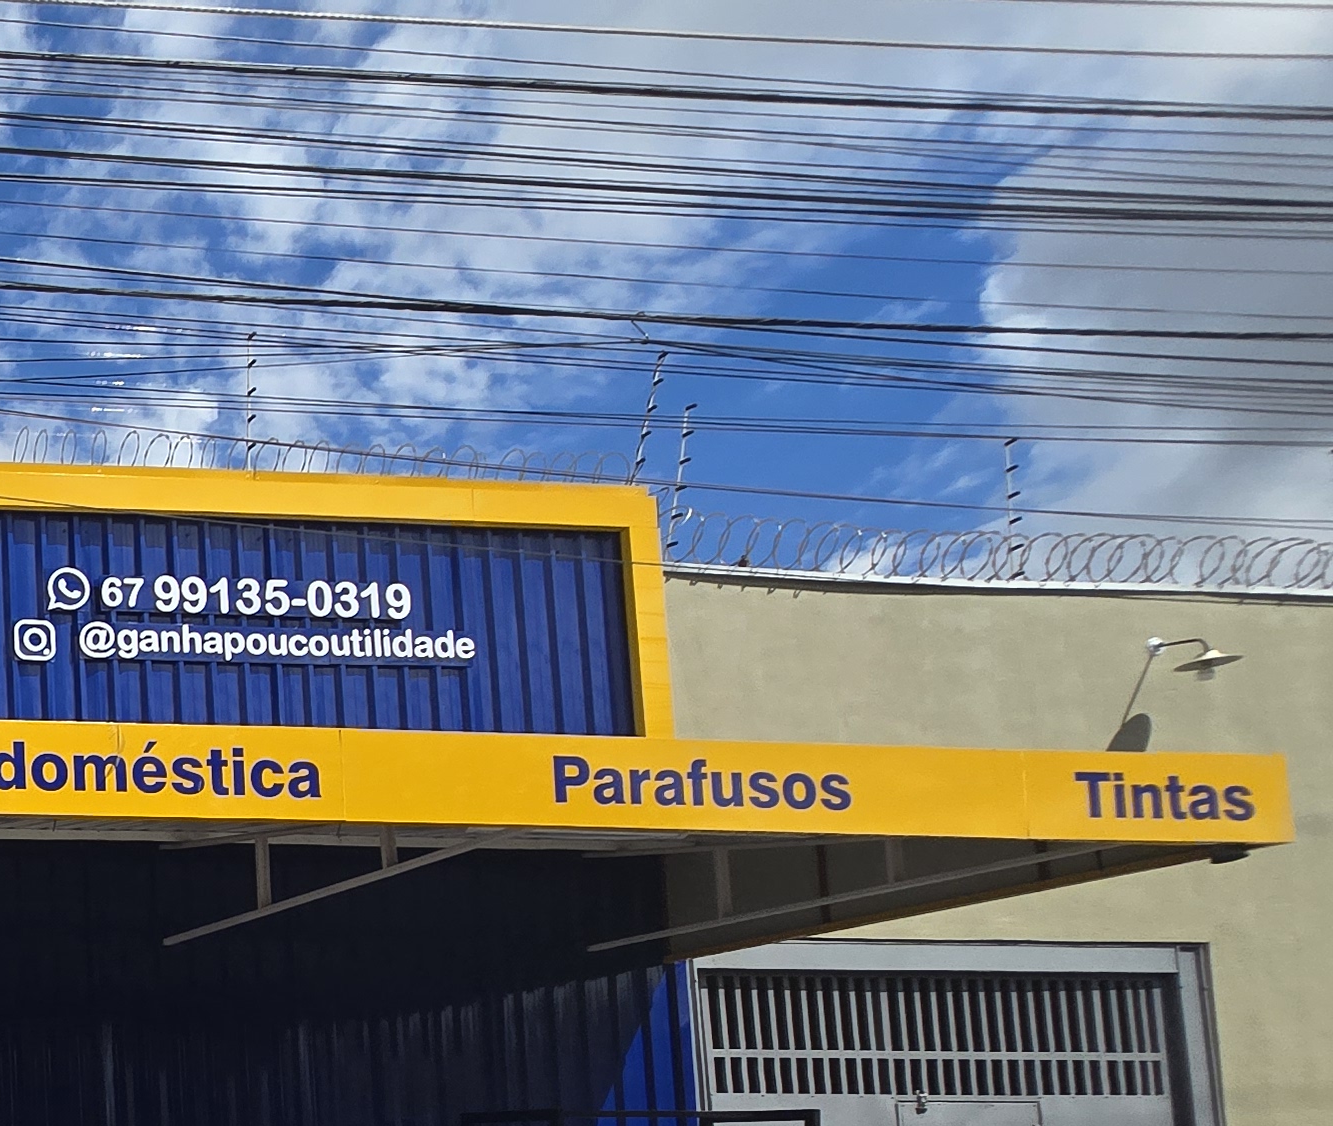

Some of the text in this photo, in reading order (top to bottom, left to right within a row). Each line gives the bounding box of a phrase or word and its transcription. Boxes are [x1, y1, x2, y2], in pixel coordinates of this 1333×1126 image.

[101, 575, 412, 620] 67 99135-0319
[79, 621, 475, 660] @ganhapoucoutilidade
[553, 757, 852, 811] Parafusos
[1075, 772, 1255, 821] Tintas
